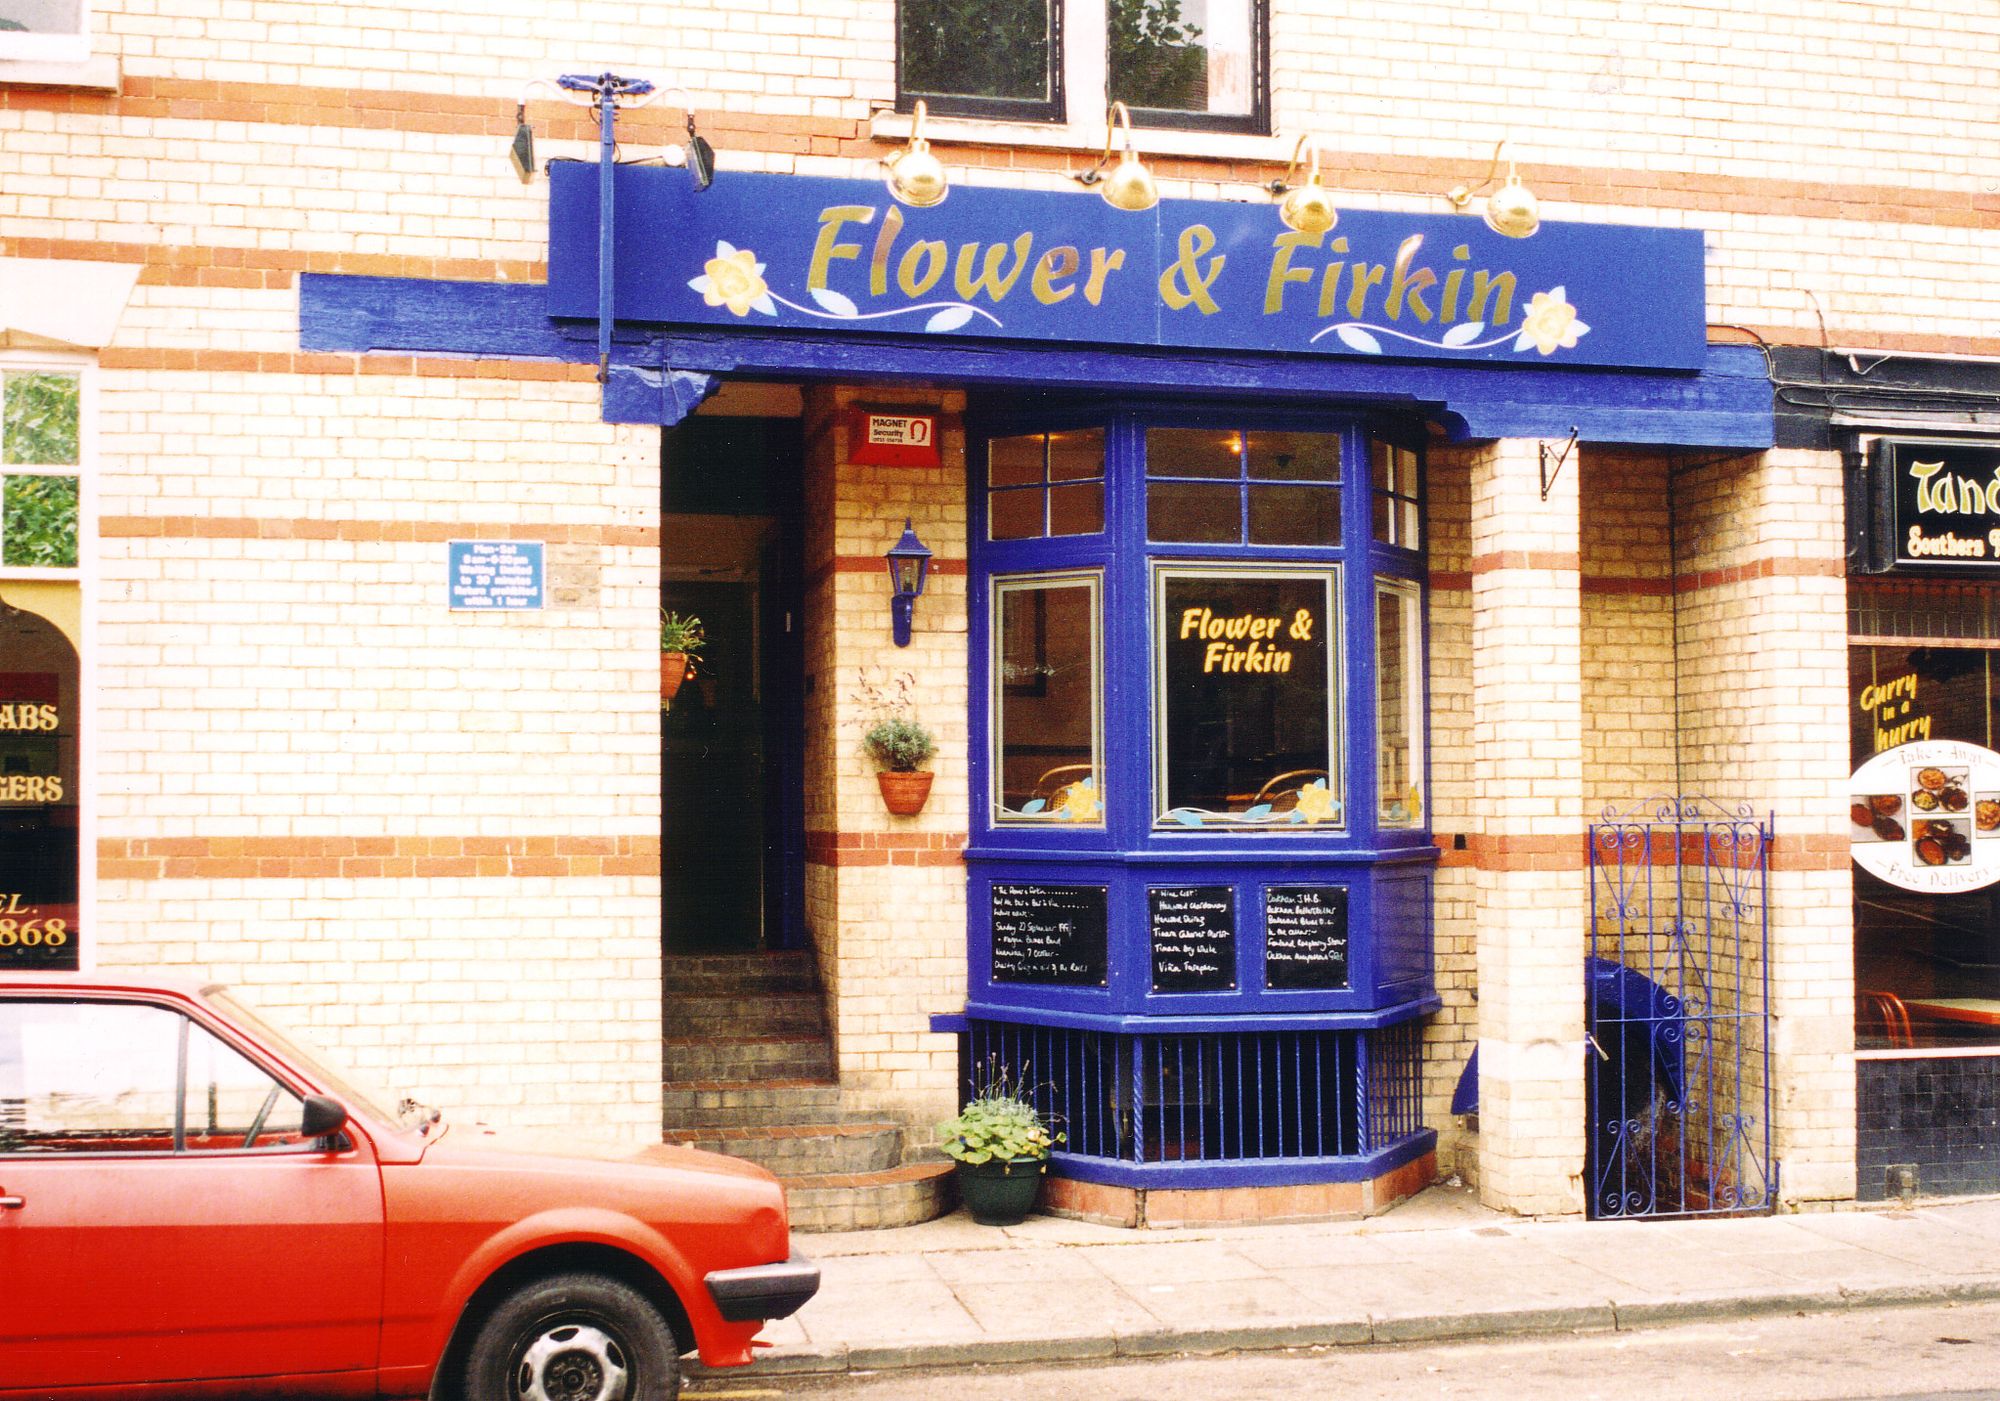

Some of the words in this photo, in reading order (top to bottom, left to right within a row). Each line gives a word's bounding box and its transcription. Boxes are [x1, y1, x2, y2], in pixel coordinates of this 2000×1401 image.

[807, 203, 1126, 308] Flower
[1158, 223, 1228, 315] &
[1262, 231, 1519, 328] Firkin
[872, 418, 907, 428] MAGNET
[873, 428, 904, 438] Security
[1907, 525, 1985, 558] Southern
[461, 576, 471, 585] to
[476, 575, 490, 585] 30
[1180, 607, 1281, 640] Flower
[1289, 608, 1313, 641] &
[1203, 641, 1292, 673] Firkin
[1860, 673, 1917, 711] Curry
[1883, 706, 1895, 721] in
[1901, 700, 1910, 714] a
[1877, 715, 1932, 752] hurry
[1160, 889, 1179, 898] Wine
